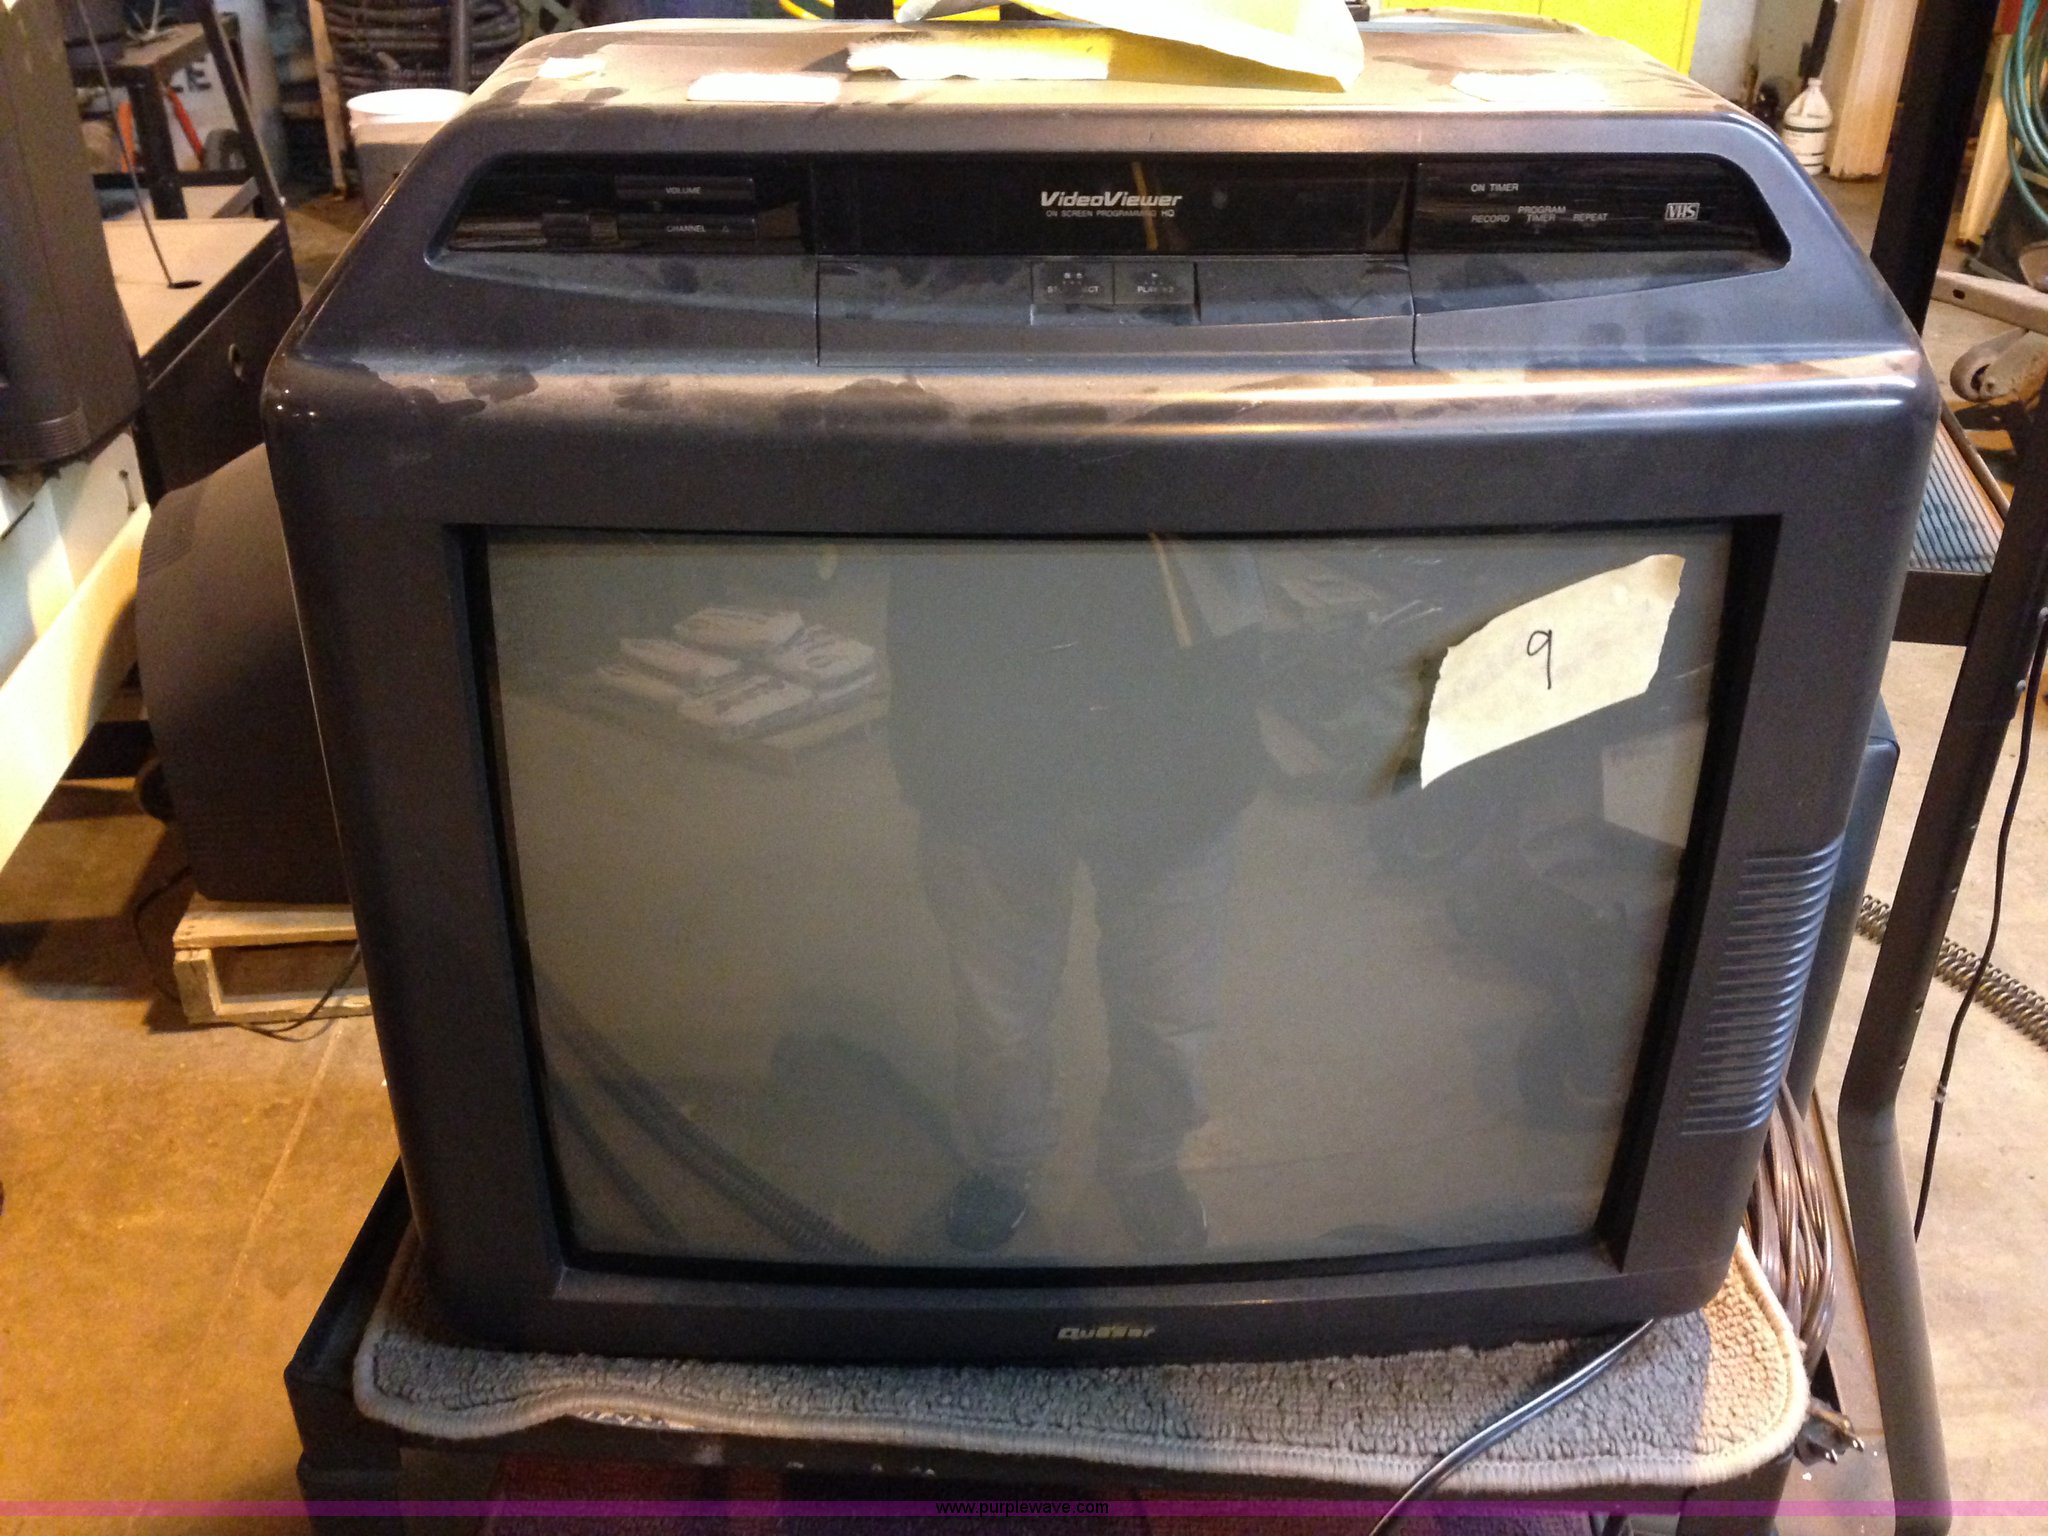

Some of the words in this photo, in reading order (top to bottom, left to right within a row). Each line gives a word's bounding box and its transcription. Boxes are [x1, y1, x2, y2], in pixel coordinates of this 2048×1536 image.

[665, 186, 702, 195] VOLUME
[1470, 182, 1486, 193] ON
[1489, 182, 1519, 193] TIMER
[1040, 190, 1183, 207] VideoViewer
[1045, 209, 1058, 218] ON
[1061, 209, 1093, 218] SCREEN
[1096, 209, 1157, 218] PROGRAMMING
[1161, 209, 1176, 218] HQ
[1517, 205, 1567, 214] PROGRAM
[1666, 203, 1698, 220] VHS
[1470, 214, 1511, 223] RECORD
[1526, 213, 1557, 223] TIMER
[1572, 212, 1609, 222] REPEAT
[666, 224, 707, 233] CHANNEL
[1526, 628, 1553, 690] 9
